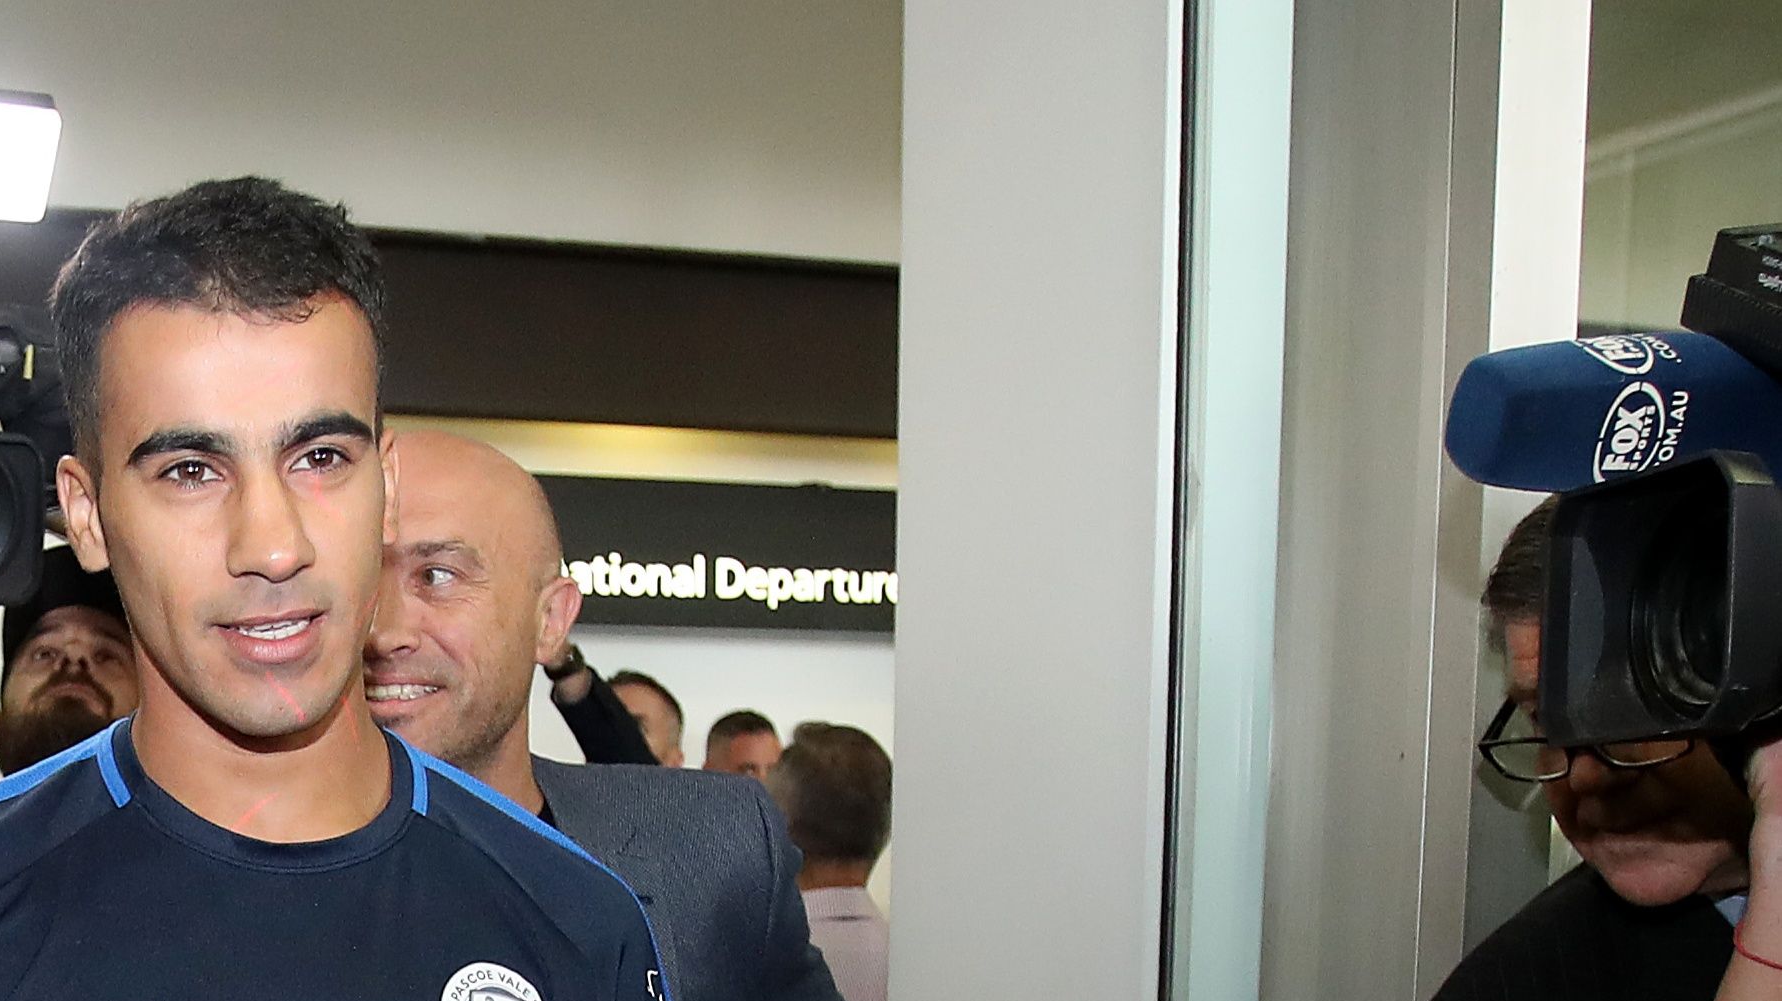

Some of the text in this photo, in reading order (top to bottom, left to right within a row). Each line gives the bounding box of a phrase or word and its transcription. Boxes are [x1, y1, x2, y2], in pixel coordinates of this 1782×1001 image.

[1601, 406, 1647, 470] FOX
[1653, 391, 1688, 466] OM.AU
[561, 553, 706, 598] ational
[450, 970, 494, 1001] PASCOE
[498, 972, 531, 998] VALE
